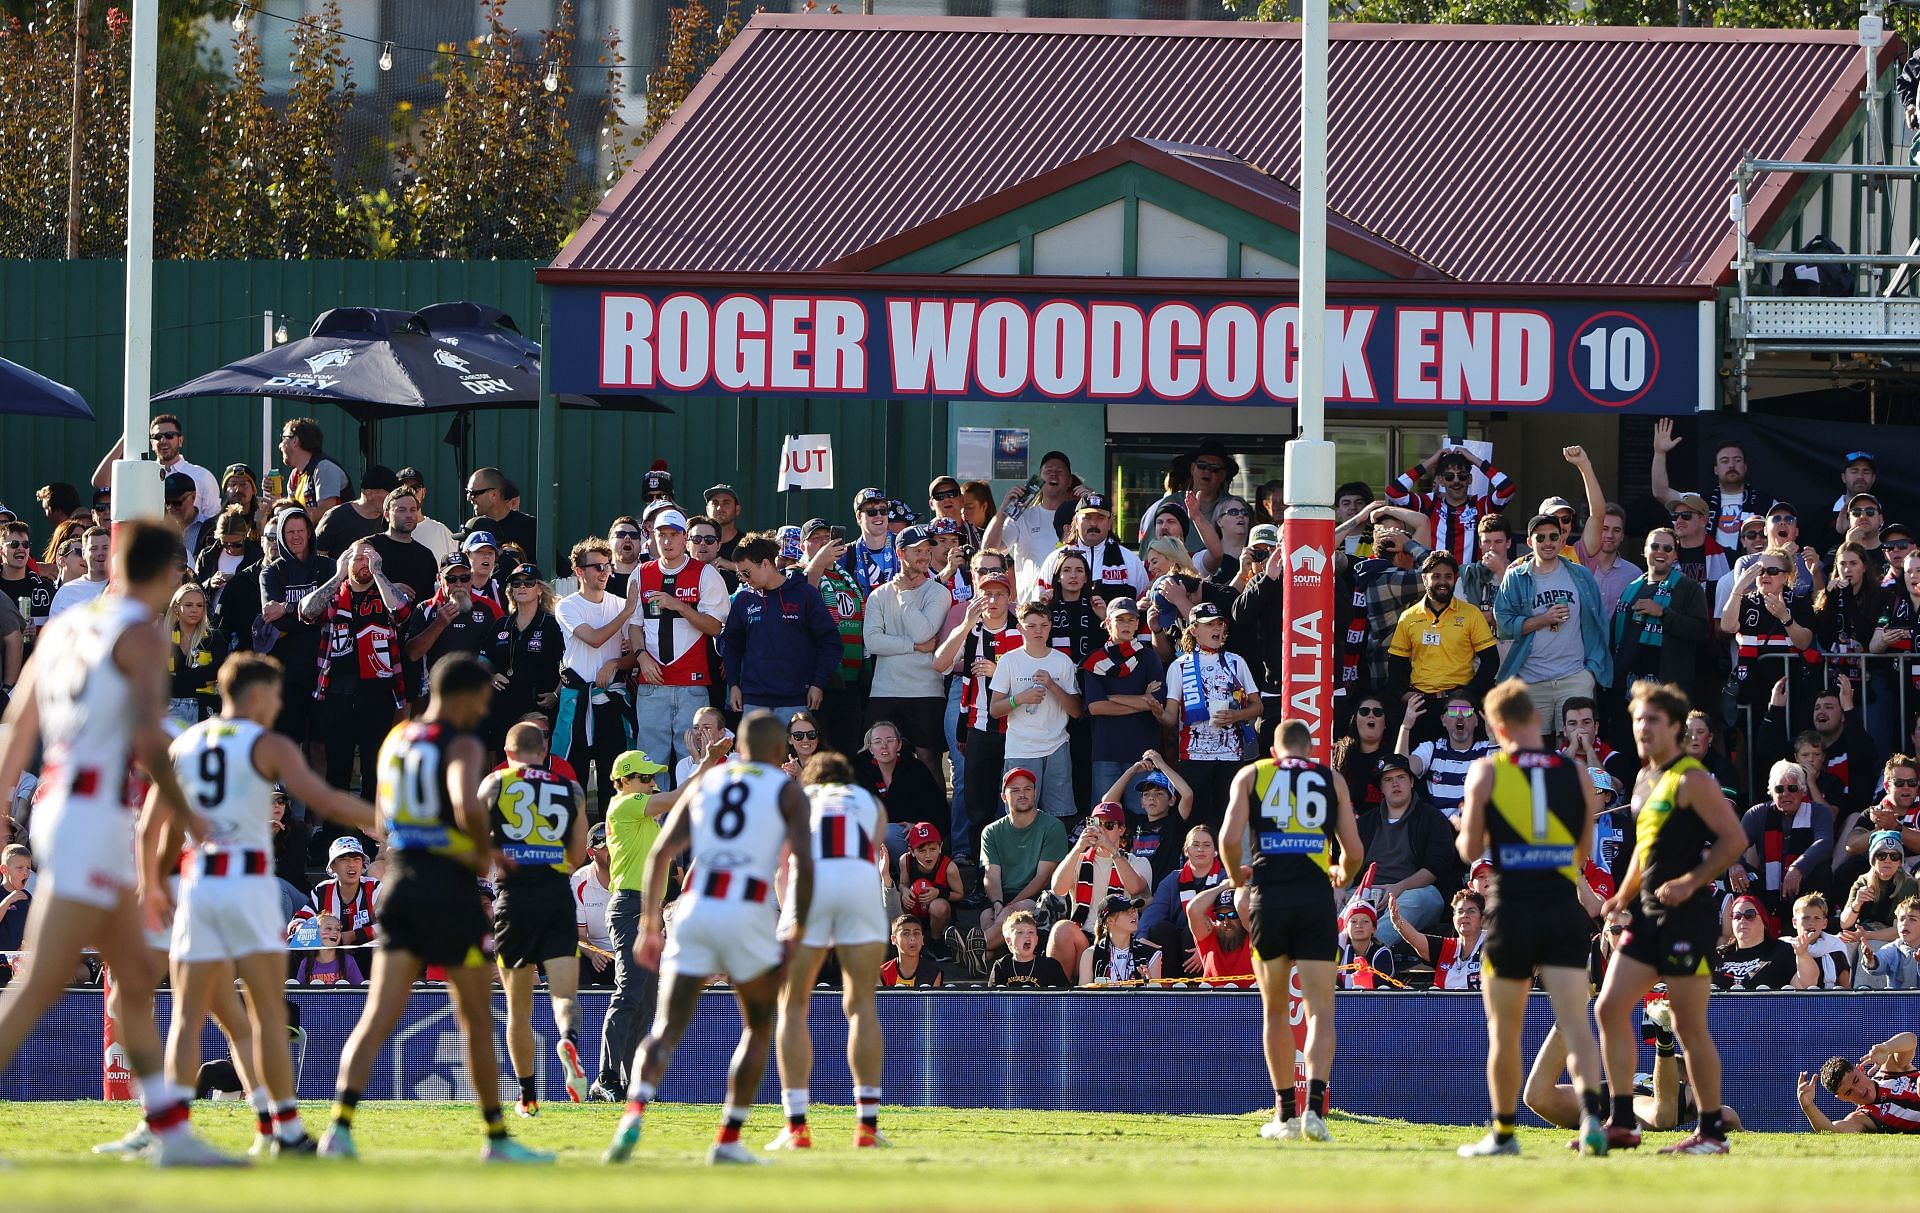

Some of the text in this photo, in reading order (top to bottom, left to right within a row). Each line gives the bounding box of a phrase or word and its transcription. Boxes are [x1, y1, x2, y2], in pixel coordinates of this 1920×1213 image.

[600, 292, 1554, 406] ROGER WOODCOCK END
[1580, 327, 1645, 391] 10
[264, 376, 341, 390] DRY
[287, 372, 334, 380] CARLTON
[461, 378, 514, 395] DRY
[1425, 632, 1437, 643] 51
[198, 747, 227, 808] 9
[523, 767, 552, 780] KFC
[1260, 769, 1327, 829] 46
[1530, 767, 1548, 839] 1
[501, 781, 569, 841] 35
[713, 781, 750, 840] 8
[1272, 838, 1325, 848] LATITUDE
[513, 848, 564, 860] LATITUDE
[107, 1071, 131, 1080] SOUTH
